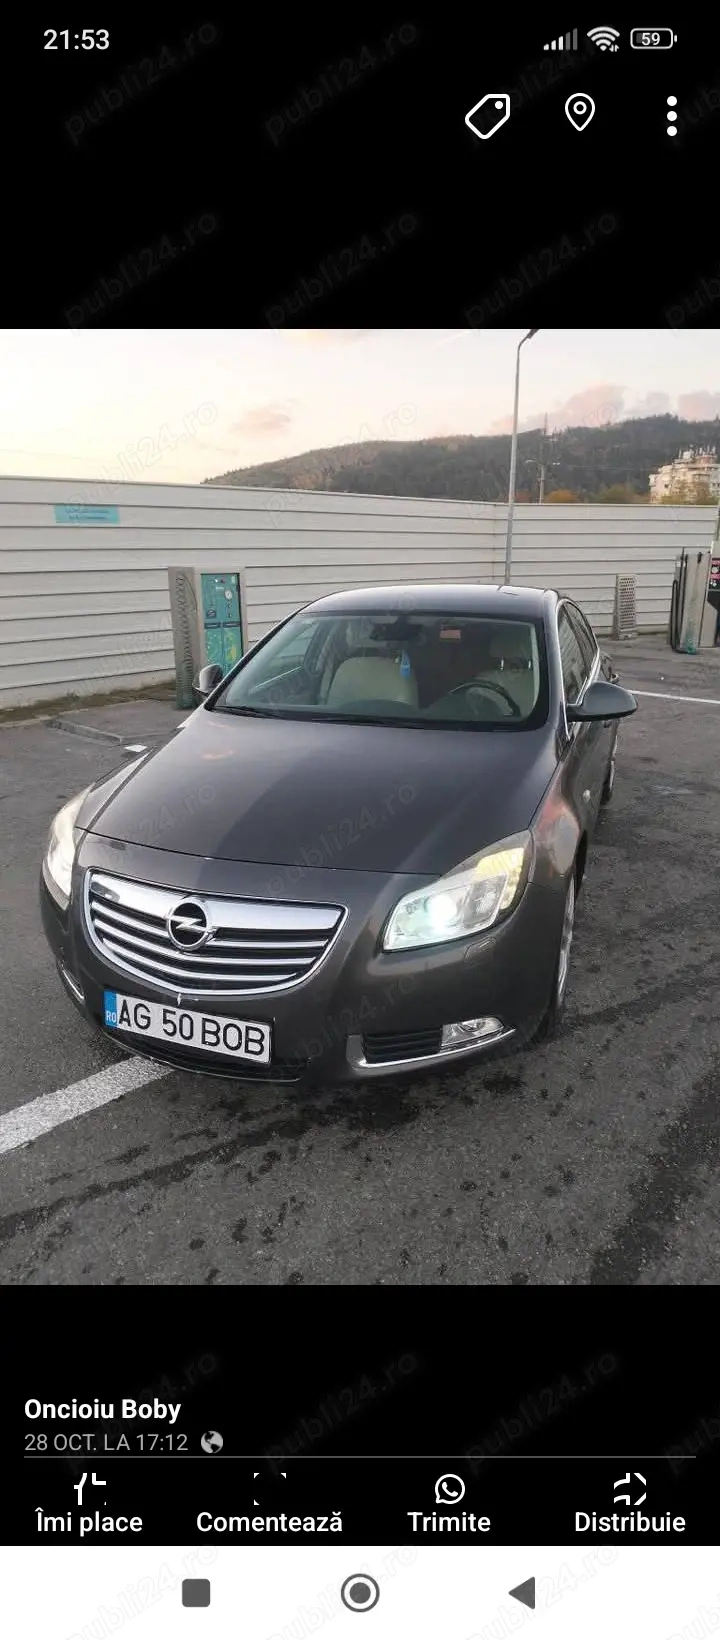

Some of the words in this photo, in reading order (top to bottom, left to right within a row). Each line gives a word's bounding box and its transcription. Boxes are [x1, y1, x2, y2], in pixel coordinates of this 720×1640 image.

[44, 29, 110, 50] 21:53
[642, 32, 660, 46] 59
[105, 1010, 118, 1024] RO
[118, 999, 152, 1031] AG
[162, 1008, 195, 1042] 50
[201, 1017, 266, 1057] BOB
[25, 1398, 114, 1419] Oncioiu
[121, 1397, 181, 1425] Boby
[24, 1433, 48, 1451] 28
[53, 1433, 97, 1451] OCT.
[104, 1433, 130, 1451] LA
[136, 1433, 188, 1451] 17:12
[35, 1507, 72, 1532] Îmi
[79, 1511, 143, 1538] place
[196, 1511, 343, 1533] Comentează
[407, 1511, 491, 1532] Trimite
[575, 1511, 686, 1533] Distribuie
